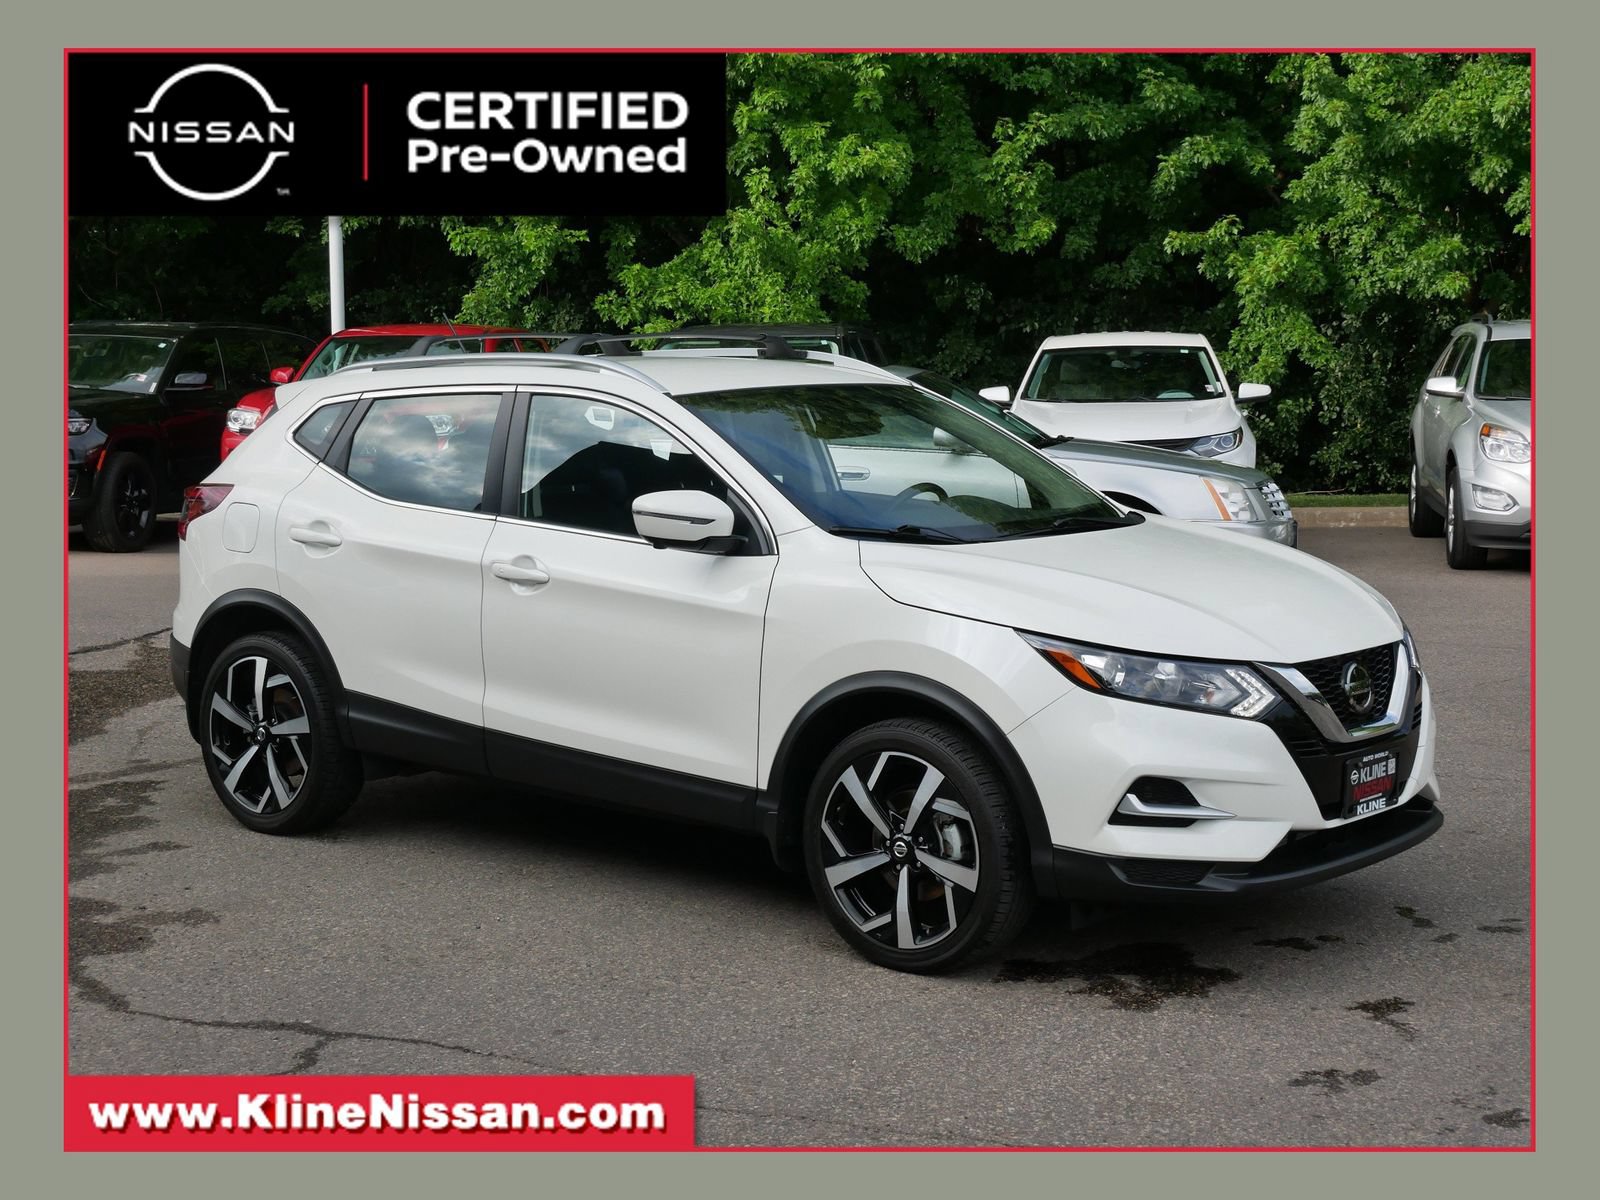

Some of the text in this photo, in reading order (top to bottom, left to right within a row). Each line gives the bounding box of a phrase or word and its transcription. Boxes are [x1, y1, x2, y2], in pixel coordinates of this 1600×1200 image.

[1360, 761, 1386, 783] KLINE
[1353, 776, 1393, 801] NISSAN
[1357, 798, 1386, 815] KLINE
